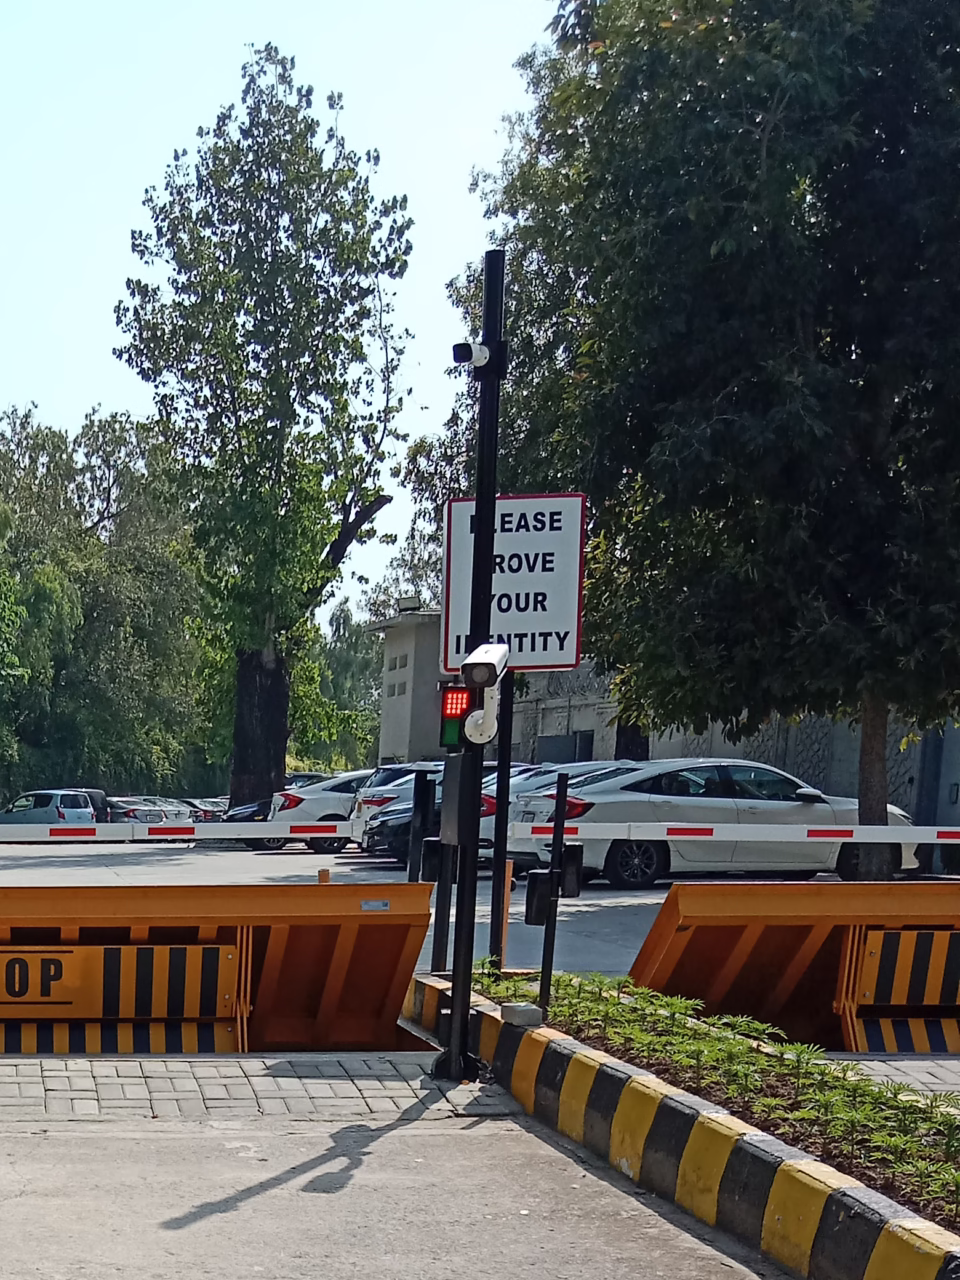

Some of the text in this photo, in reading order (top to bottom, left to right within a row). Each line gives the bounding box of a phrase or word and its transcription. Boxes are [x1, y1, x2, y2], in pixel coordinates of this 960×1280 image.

[470, 511, 563, 534] EASE
[492, 552, 555, 574] ROVE
[455, 631, 570, 655] INTITY
